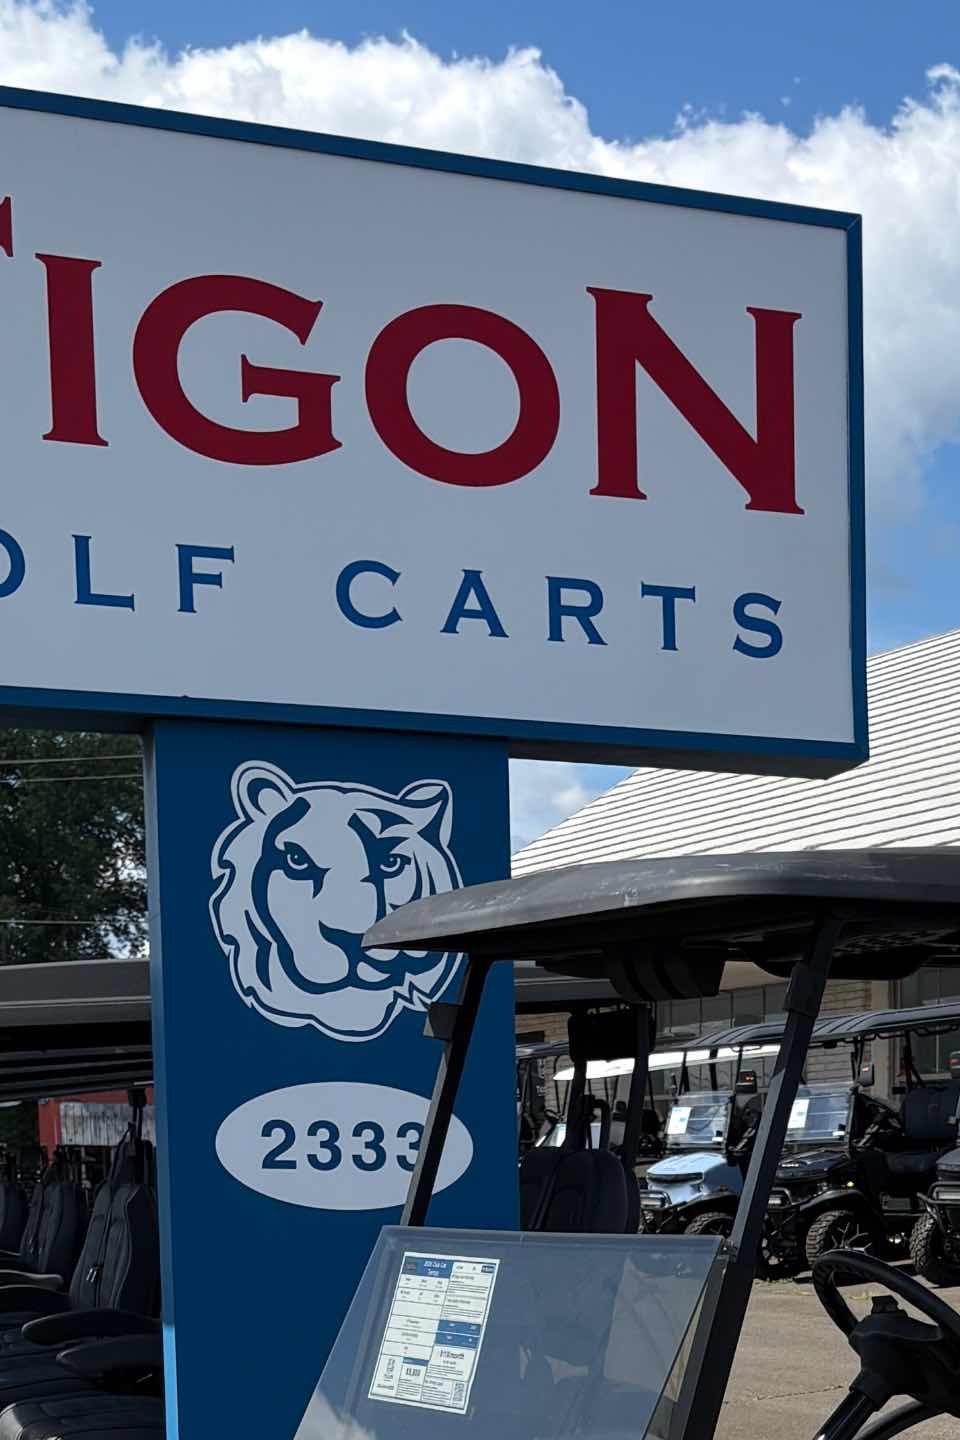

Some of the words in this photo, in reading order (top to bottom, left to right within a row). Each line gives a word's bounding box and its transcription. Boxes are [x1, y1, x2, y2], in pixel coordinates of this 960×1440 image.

[0, 196, 804, 515] IGON
[336, 560, 783, 659] CARTS
[261, 1119, 425, 1172] 2333
